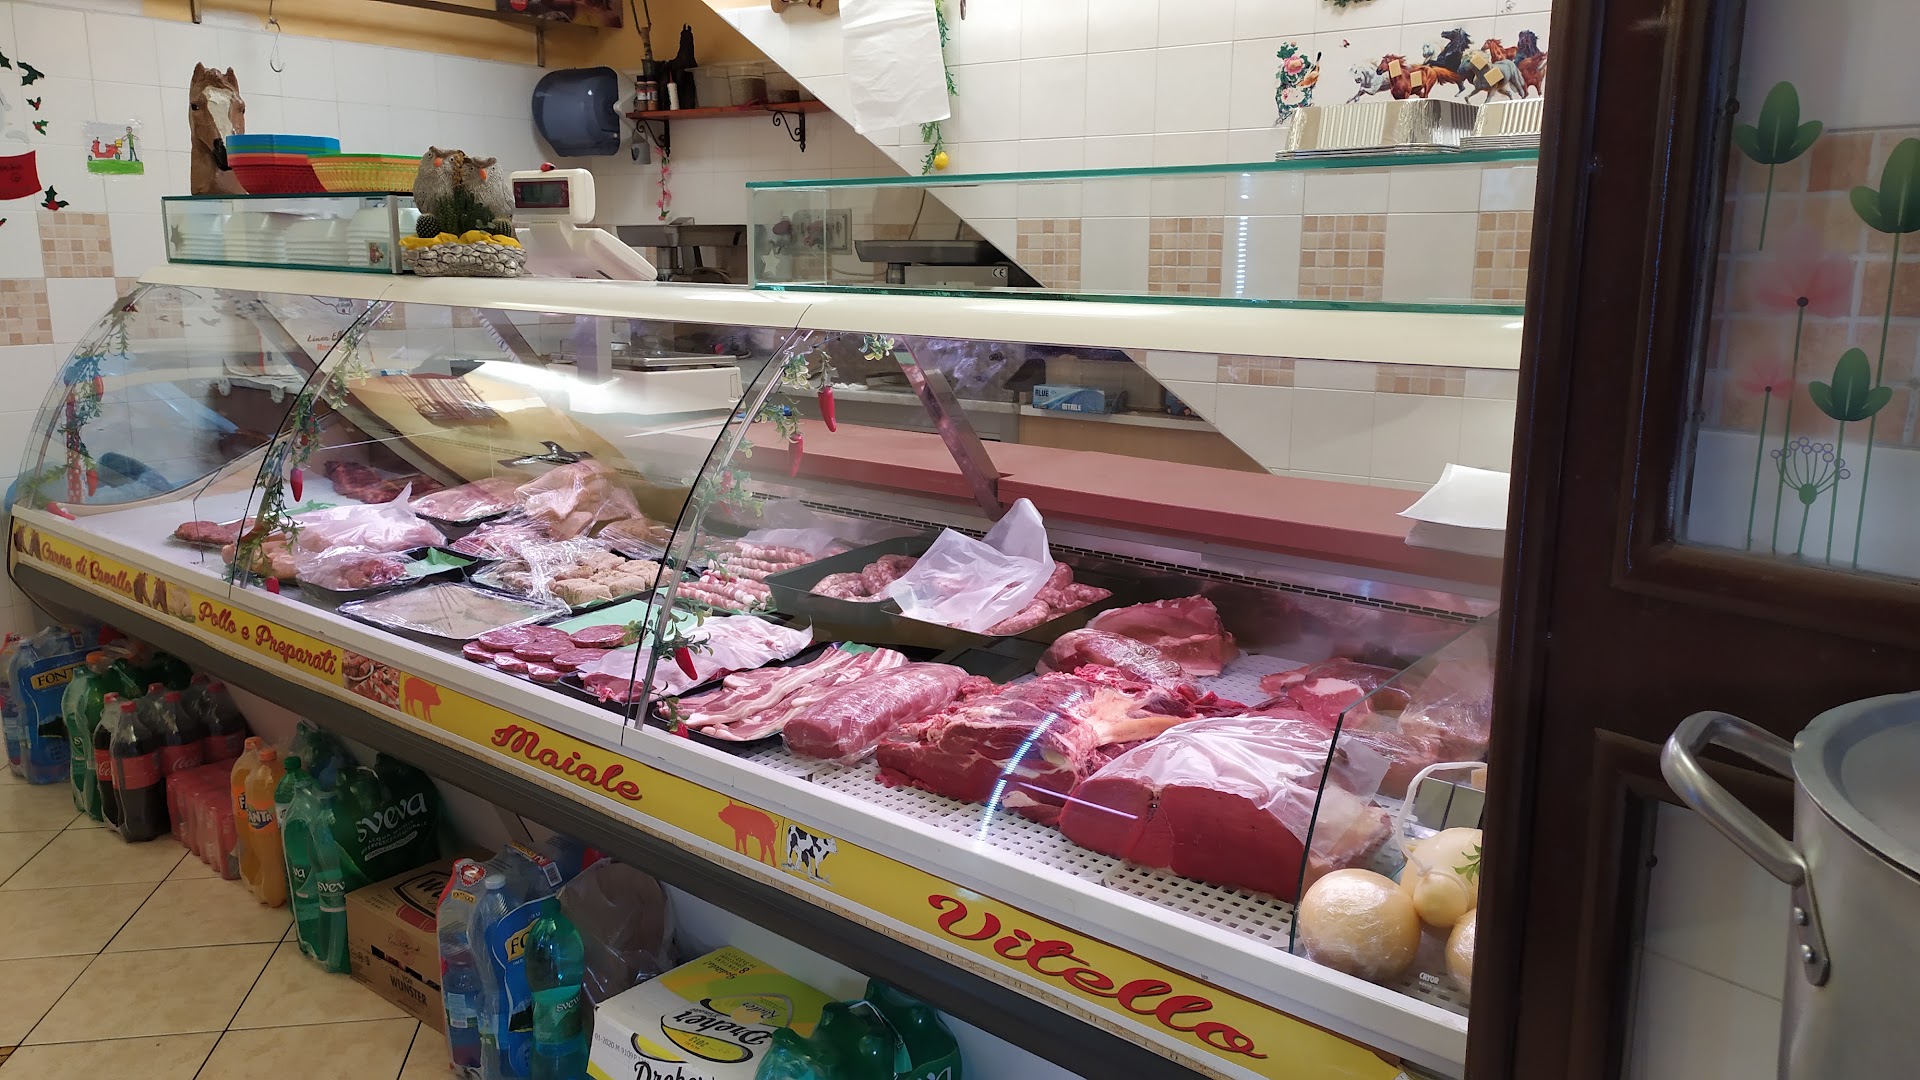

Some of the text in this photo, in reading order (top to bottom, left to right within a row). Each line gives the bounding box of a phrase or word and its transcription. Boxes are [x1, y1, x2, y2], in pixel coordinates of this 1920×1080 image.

[1035, 388, 1049, 397] BLUE
[1061, 402, 1082, 411] NITRILE
[41, 543, 133, 595] Carne di Cavallo
[199, 601, 337, 675] Pollo e Preparati
[491, 724, 643, 800] Maiale
[356, 792, 428, 843] sveva
[928, 894, 1267, 1059] Vitello
[672, 1010, 773, 1046] Dreher
